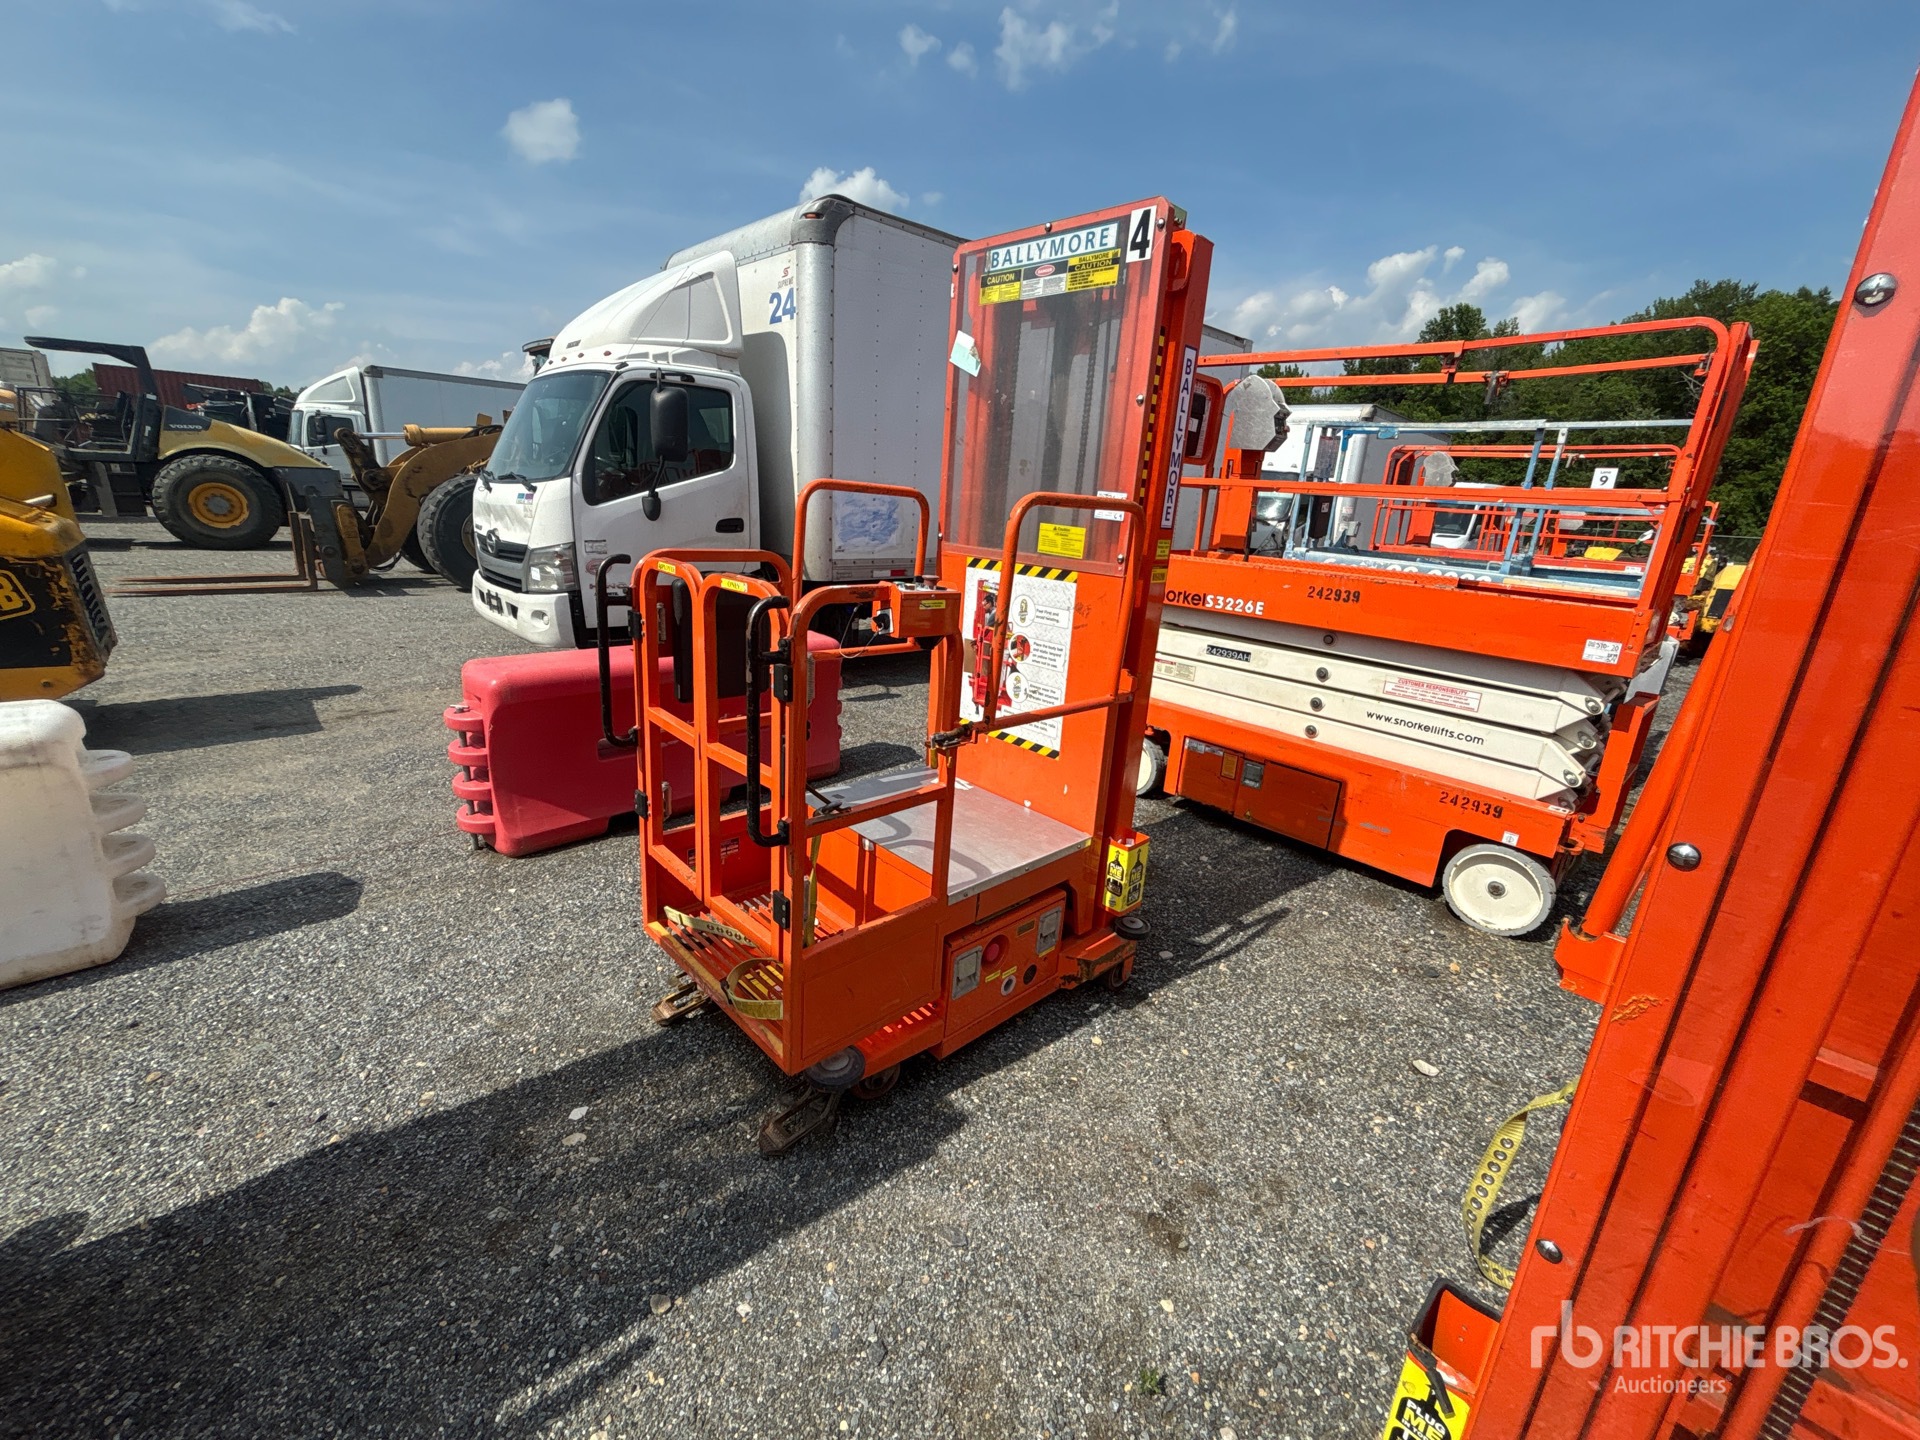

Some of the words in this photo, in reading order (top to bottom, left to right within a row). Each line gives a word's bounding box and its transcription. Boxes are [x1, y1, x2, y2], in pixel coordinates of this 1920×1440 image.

[1129, 208, 1151, 259] 4
[991, 227, 1110, 268] BALLYMORE
[1078, 251, 1110, 263] BALLYMORE
[1074, 259, 1112, 271] CAUTION
[986, 273, 1015, 285] CAUTION
[769, 287, 796, 325] 24
[1164, 358, 1192, 522] BALLYMORE
[1599, 475, 1609, 486] 9
[1165, 589, 1207, 607] orkel
[1205, 594, 1265, 616] S3226E
[1307, 585, 1361, 604] 242939
[1206, 646, 1252, 663] 242939AH
[1397, 679, 1425, 688] CUSTOMER
[1425, 683, 1468, 696] RESPONSIBILITY
[1366, 711, 1485, 746] www.snorkellifts.com
[1439, 791, 1504, 819] 242939
[1109, 867, 1122, 877] ME
[1406, 1398, 1446, 1436] PLUG
